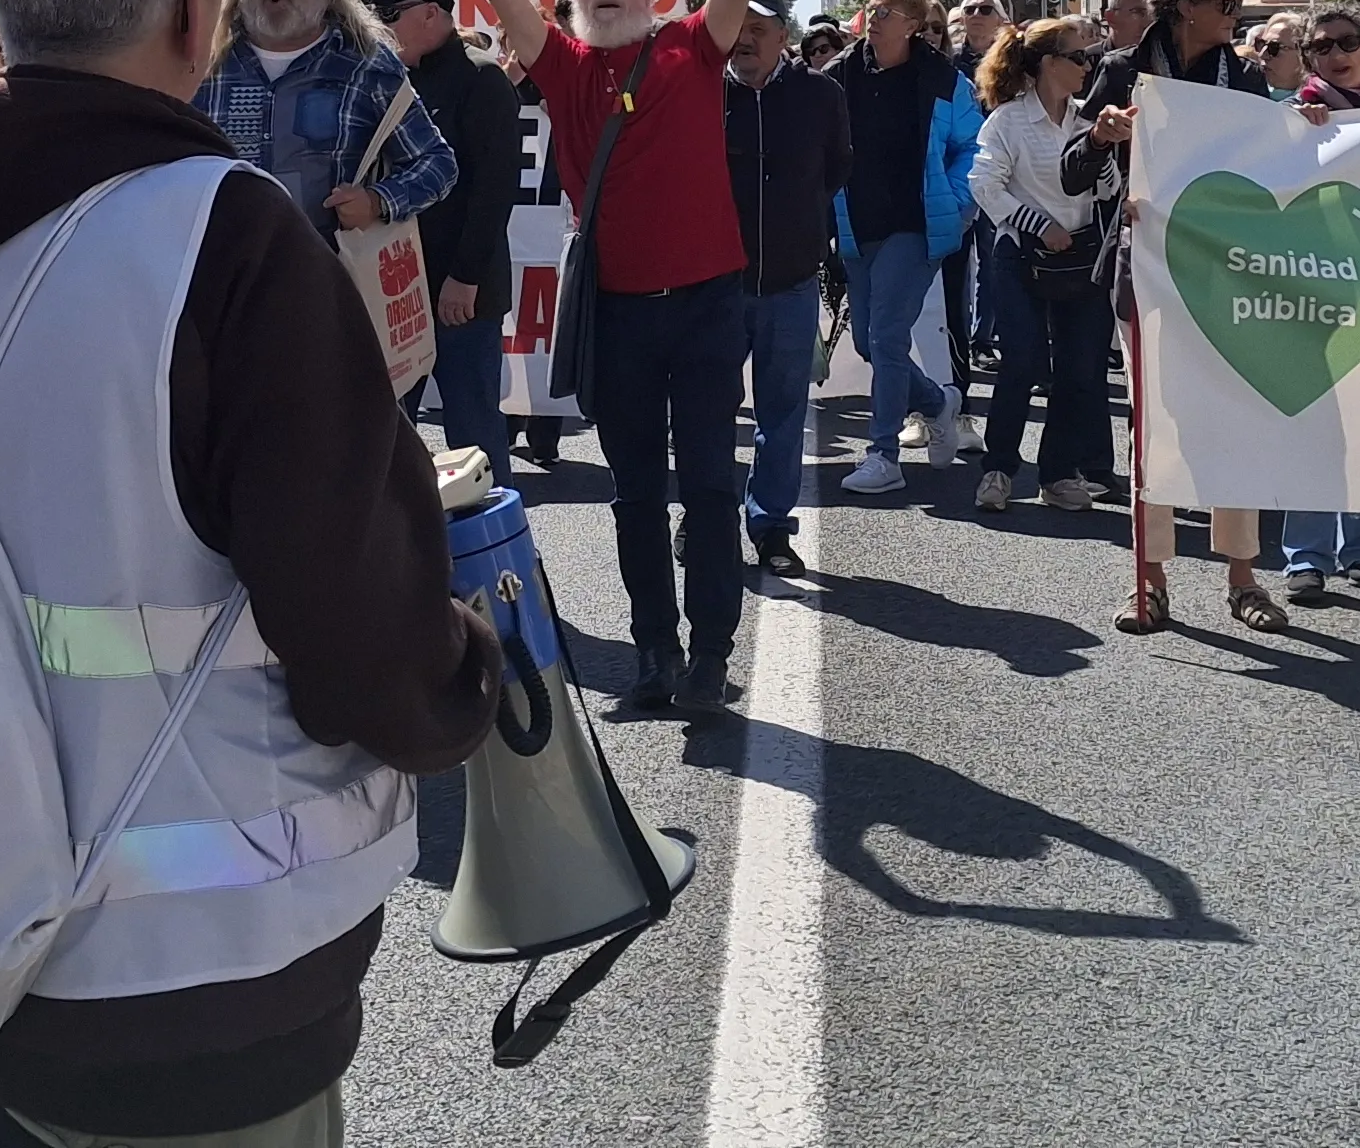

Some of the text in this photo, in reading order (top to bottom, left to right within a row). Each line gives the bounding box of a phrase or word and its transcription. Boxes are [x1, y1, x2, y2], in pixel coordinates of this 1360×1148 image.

[1227, 246, 1360, 282] Sanidad
[386, 286, 424, 328] ORGULLO
[1231, 290, 1357, 329] pública
